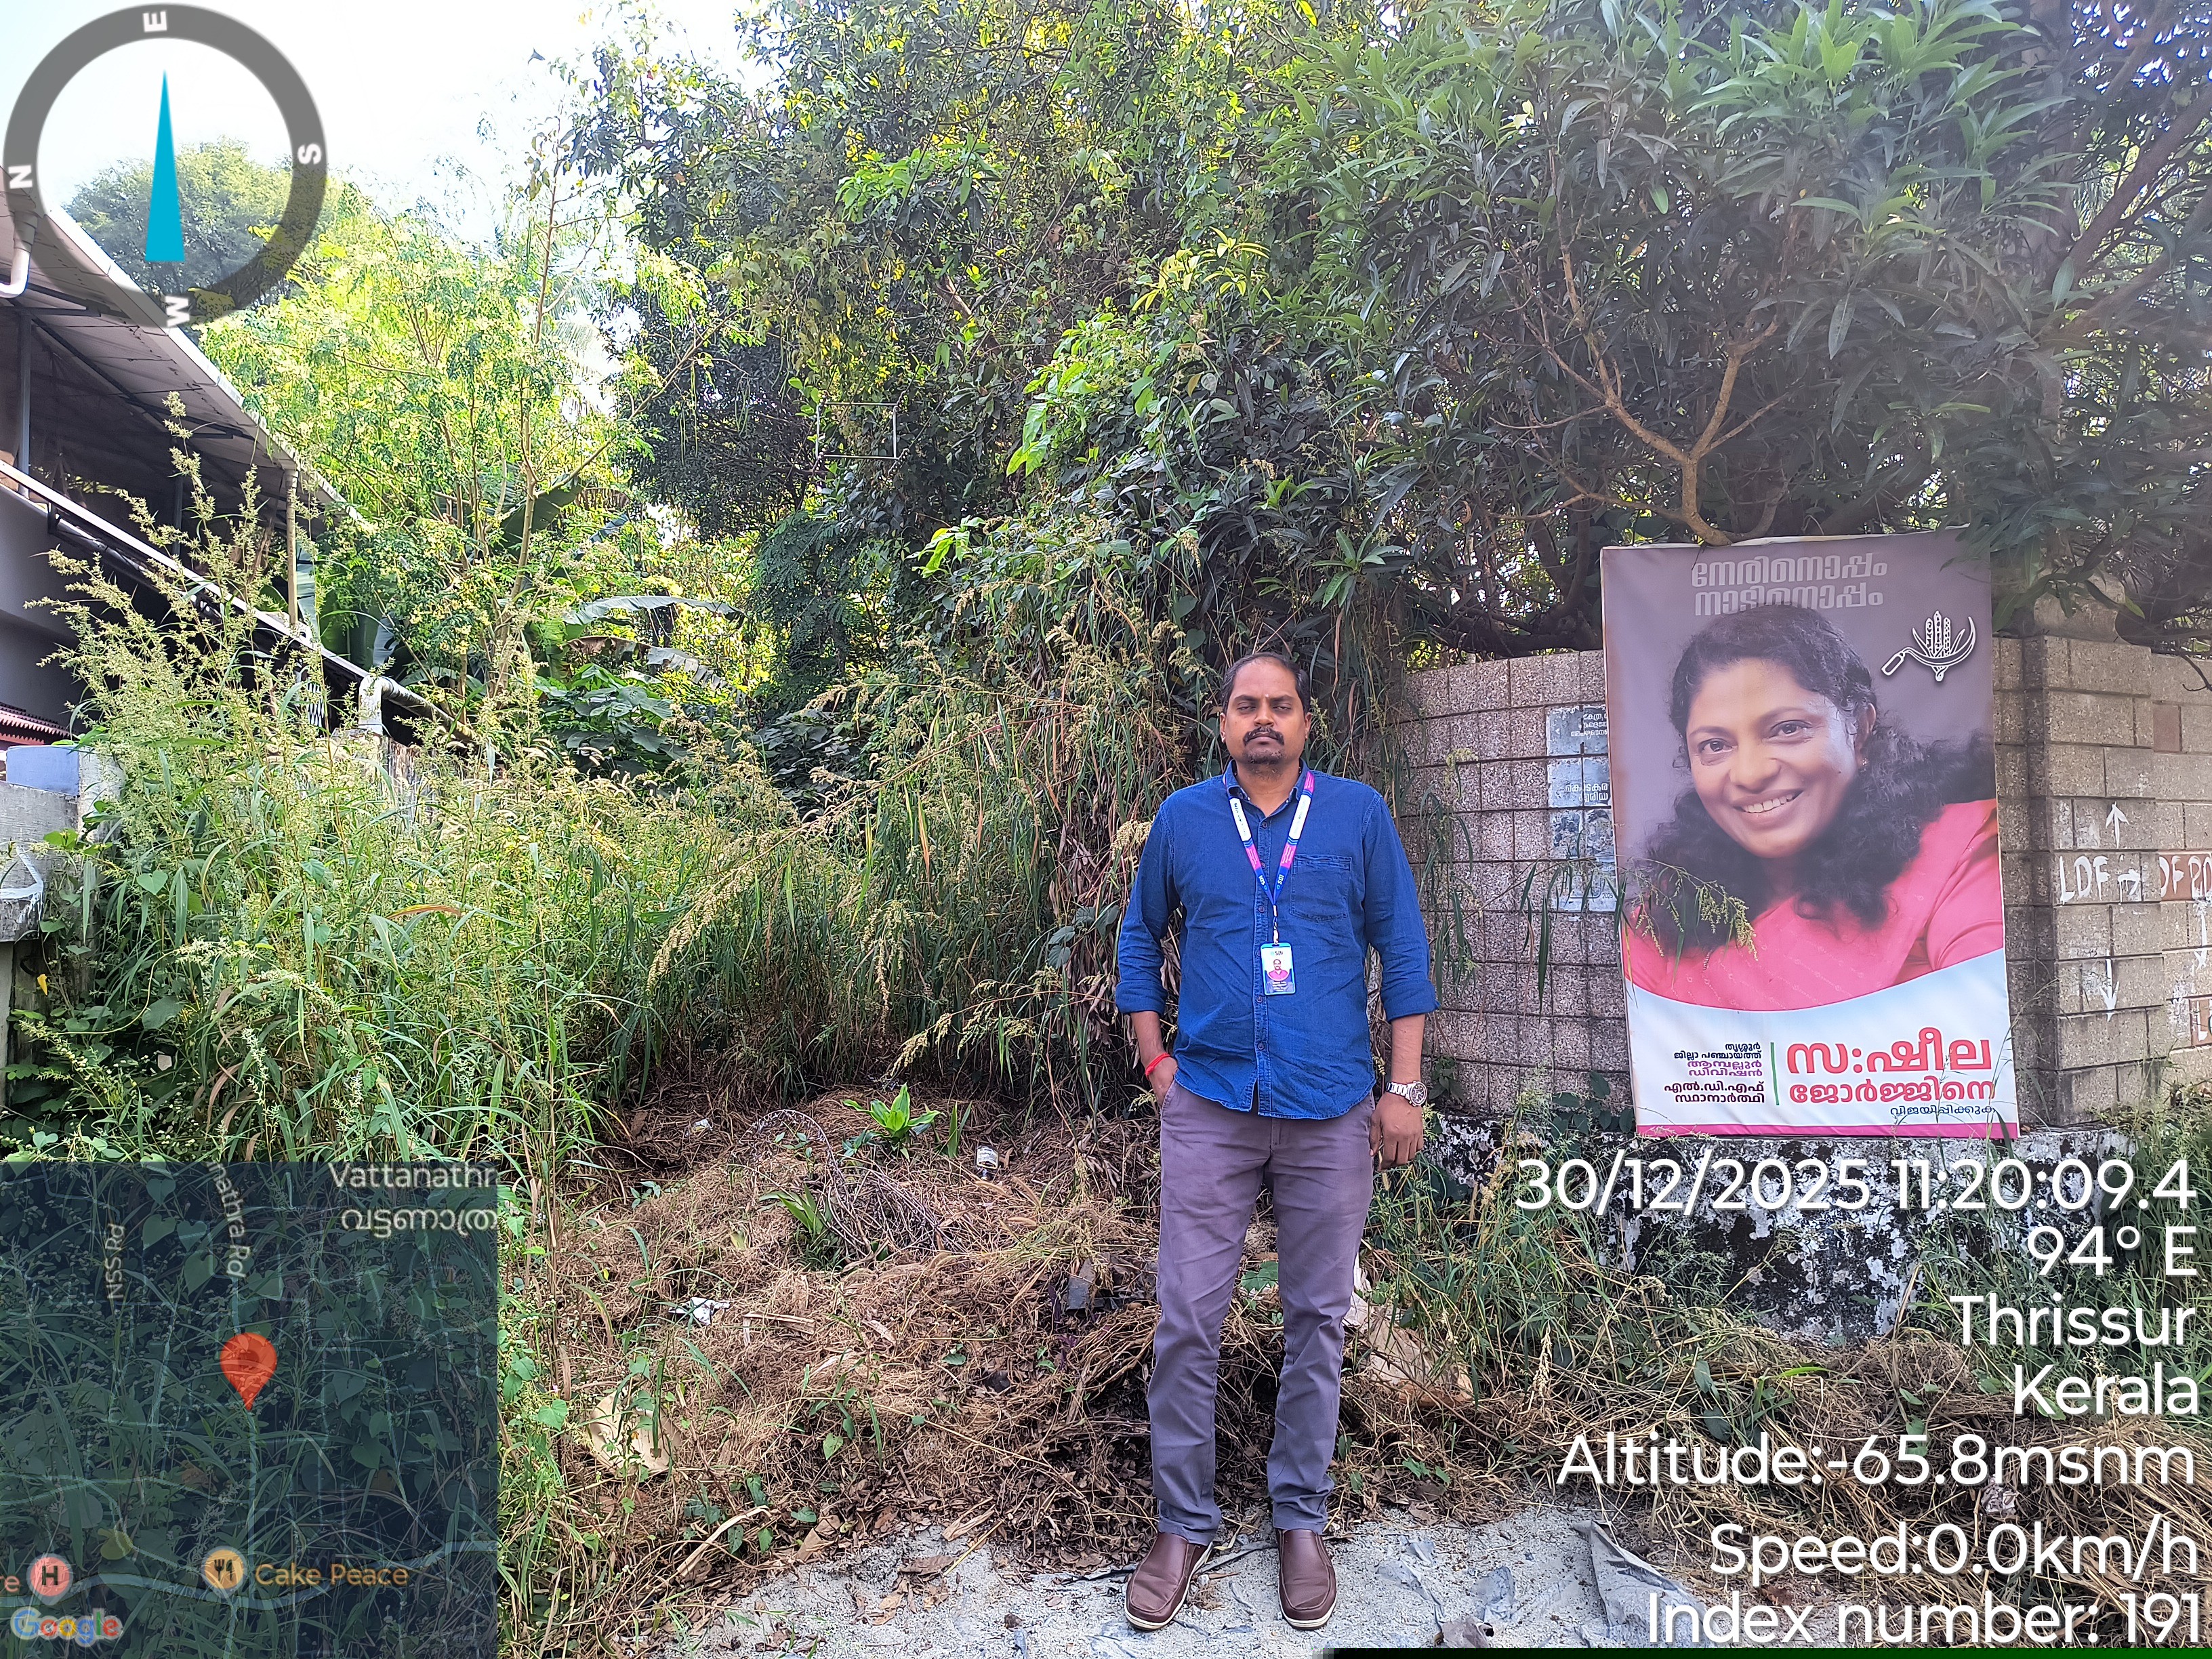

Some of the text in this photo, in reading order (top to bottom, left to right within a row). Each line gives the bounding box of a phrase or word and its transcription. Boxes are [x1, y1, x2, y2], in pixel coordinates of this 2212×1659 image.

[1692, 553, 1887, 587] നേരിനൊപ്പം
[2059, 855, 2110, 904] LDF
[1674, 1050, 1762, 1061] ജില്ലാ പഞ്ചായത്ത്
[1688, 1068, 1763, 1076] ഡിവിഷൻ
